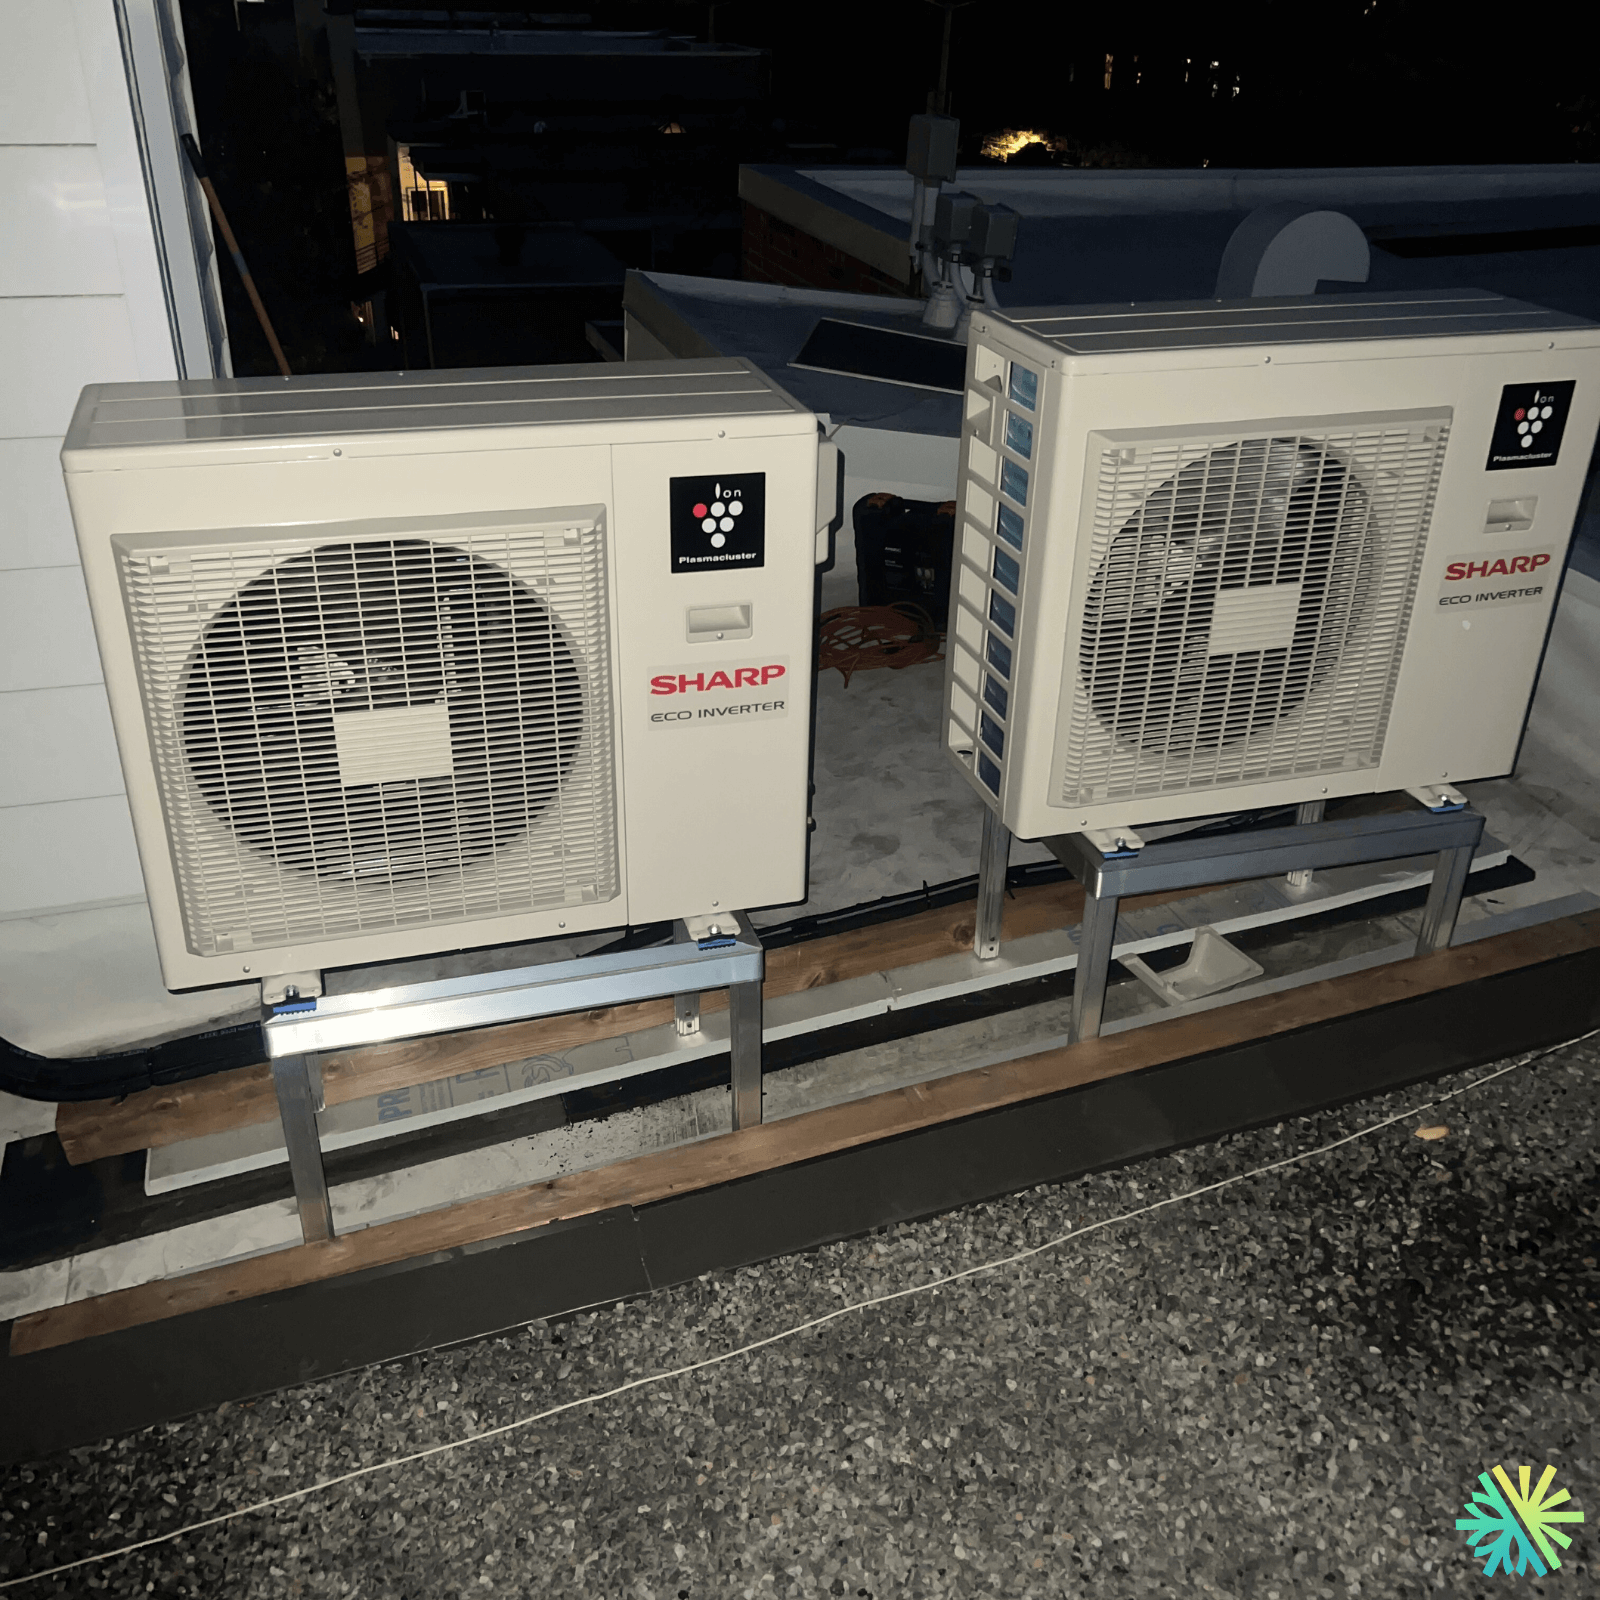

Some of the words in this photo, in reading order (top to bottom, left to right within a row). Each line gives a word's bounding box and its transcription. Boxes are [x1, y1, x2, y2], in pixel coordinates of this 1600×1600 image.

[1534, 389, 1554, 403] Ion
[1493, 452, 1553, 462] Plasmacluster
[715, 482, 741, 499] Ion
[679, 552, 757, 564] Plasmacluster
[1444, 553, 1551, 581] SHARP
[1439, 594, 1472, 605] ECO
[1475, 587, 1543, 602] INVERTER
[650, 664, 786, 696] SHARP
[650, 710, 692, 722] ECO
[698, 701, 785, 718] INVERTER
